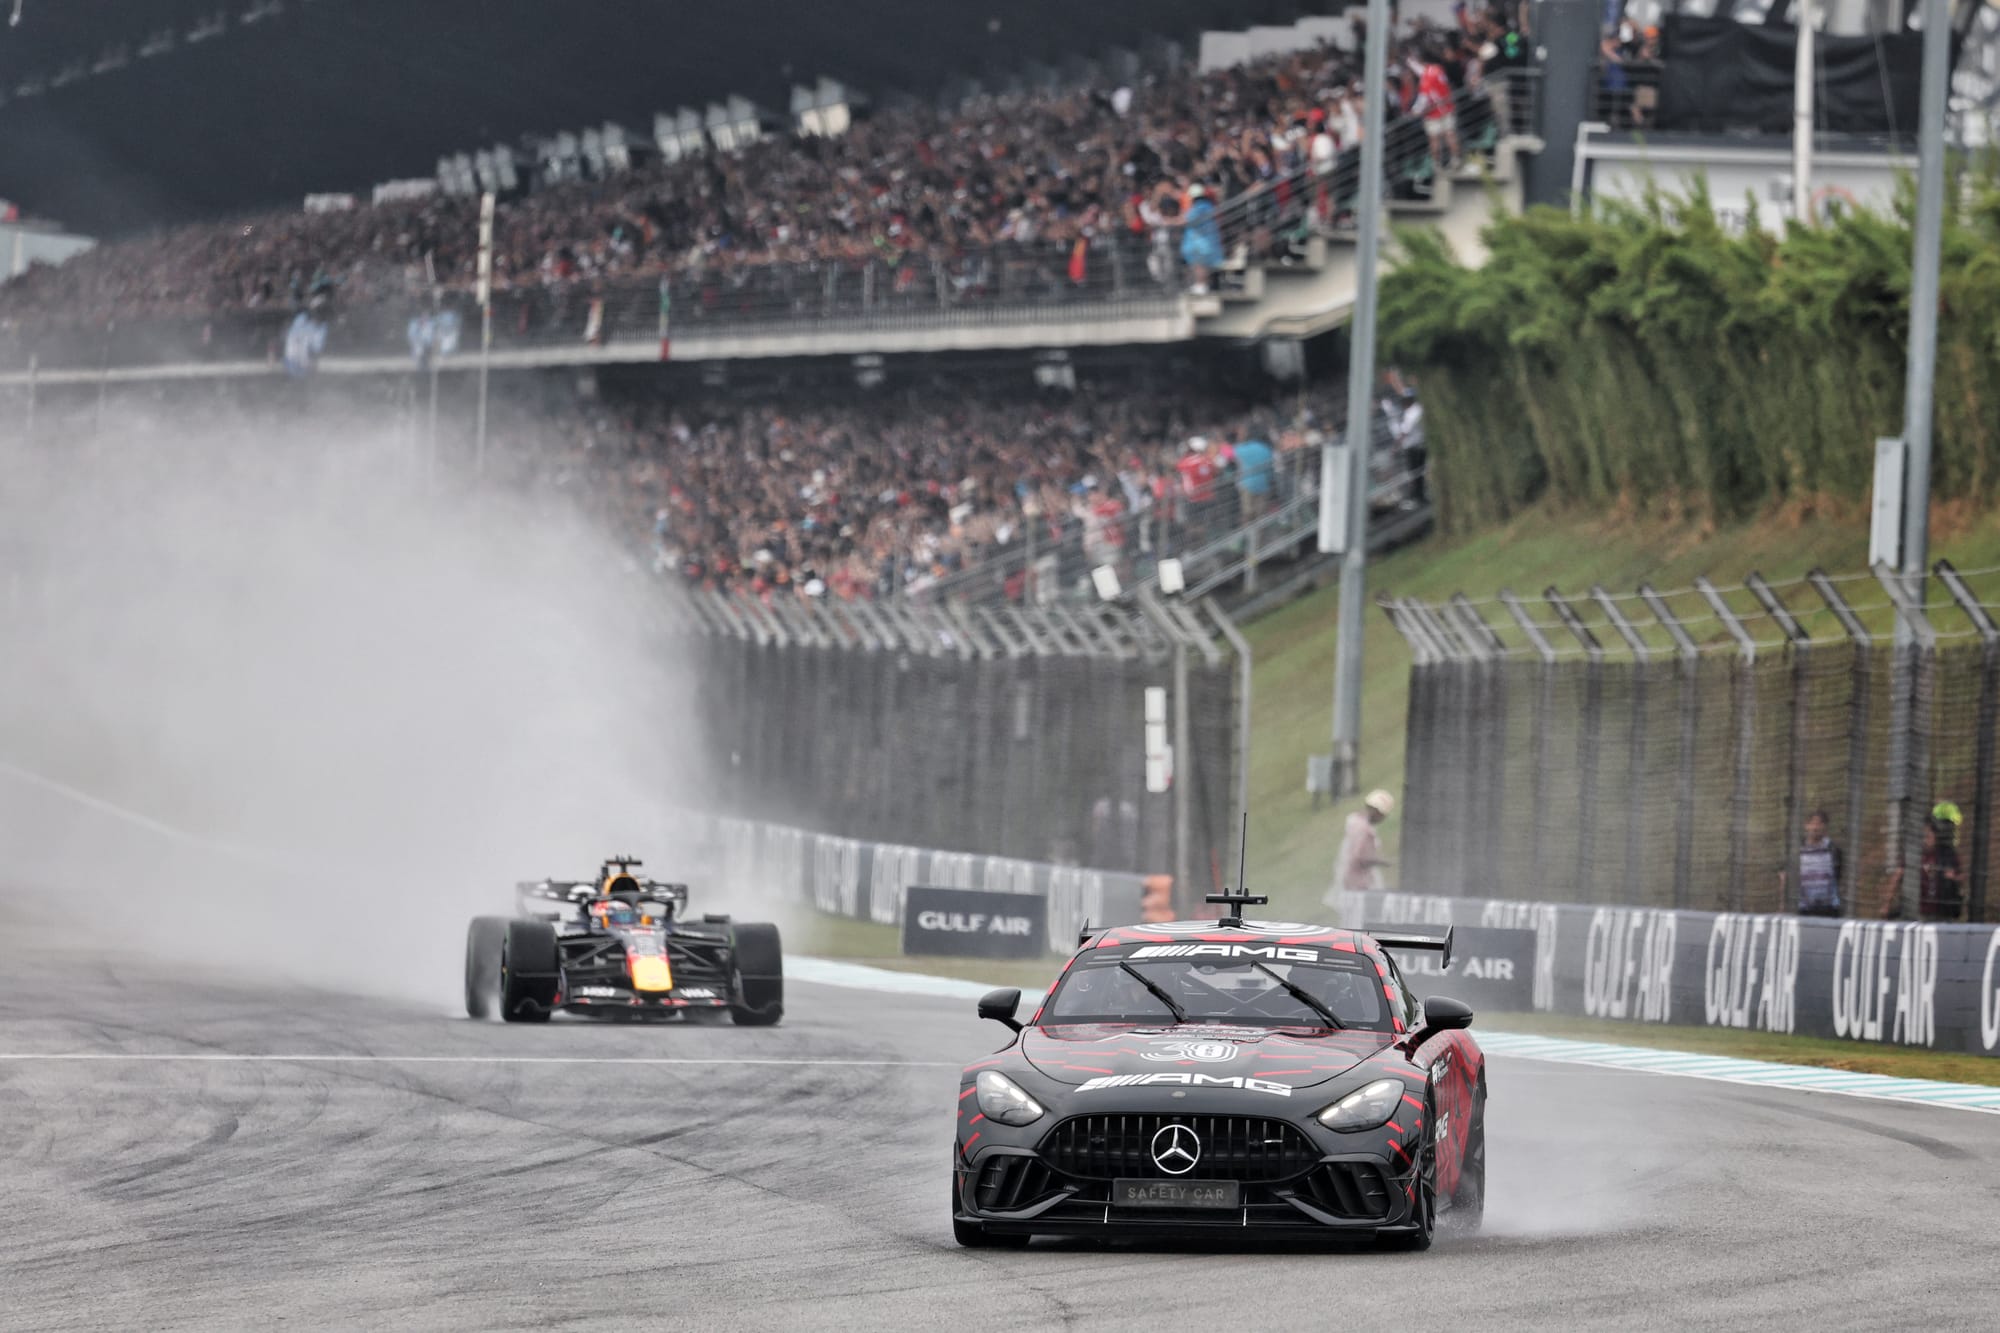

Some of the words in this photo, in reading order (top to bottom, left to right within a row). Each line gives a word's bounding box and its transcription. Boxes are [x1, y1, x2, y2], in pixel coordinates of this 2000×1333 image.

[917, 910, 986, 932] GULF
[987, 914, 1032, 936] AIR
[1187, 945, 1318, 962] AMG
[1584, 908, 1644, 1018] GULF
[1634, 911, 1677, 1023] AIR
[1461, 956, 1515, 981] AIR
[1705, 912, 1766, 1028] GULF
[1757, 915, 1799, 1035] AIR
[1833, 920, 1897, 1041] GULF
[1892, 921, 1938, 1048] AIR
[1140, 1041, 1239, 1063] 30
[1139, 1073, 1293, 1097] AMG
[1127, 1187, 1187, 1200] SAFETY
[1194, 1188, 1224, 1200] CAR
